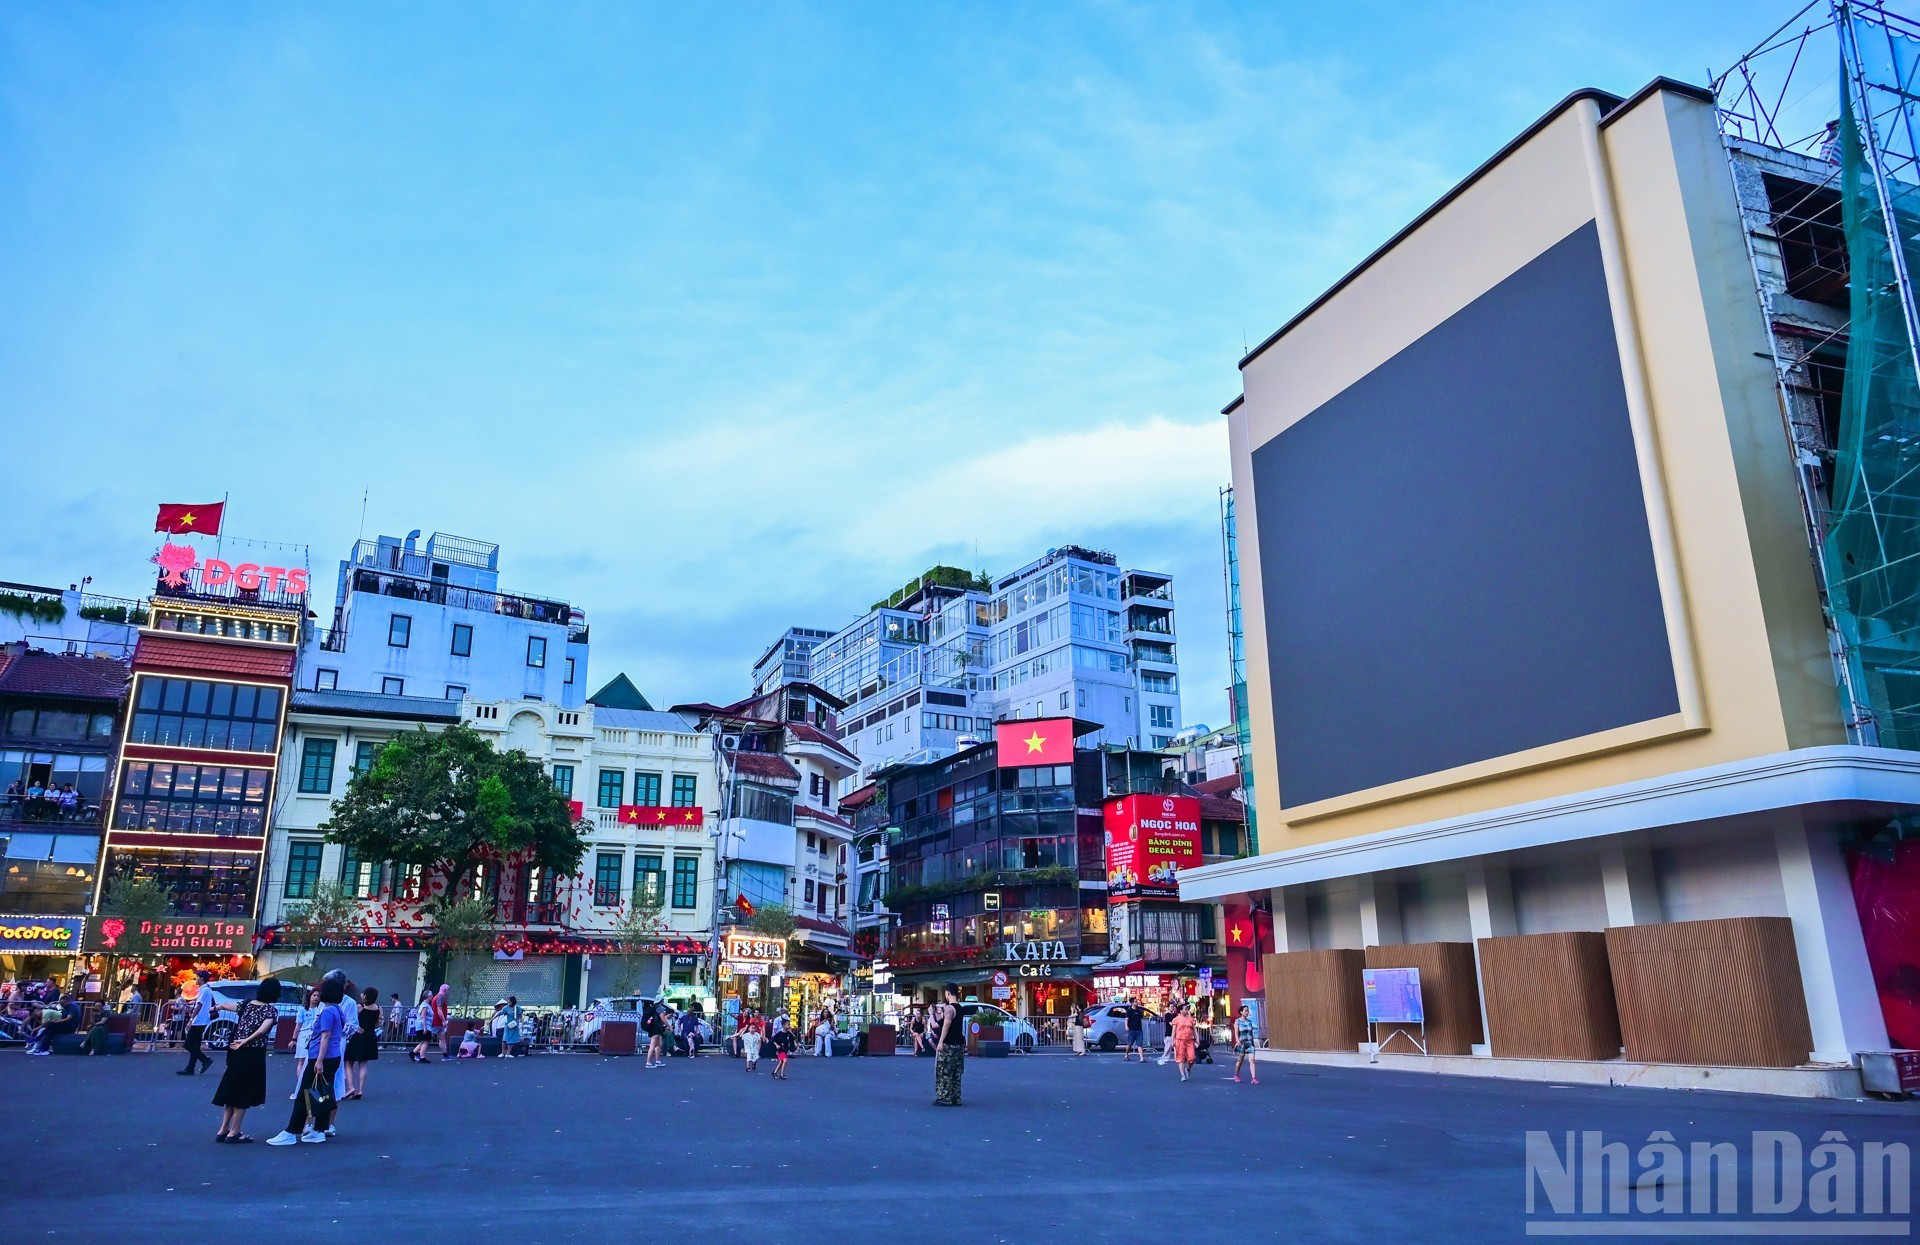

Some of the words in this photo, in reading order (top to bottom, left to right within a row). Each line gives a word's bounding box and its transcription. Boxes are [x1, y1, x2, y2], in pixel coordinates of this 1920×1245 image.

[202, 558, 307, 595] DGTS
[1140, 818, 1172, 831] NGỌC
[1175, 821, 1197, 831] HOA
[139, 919, 210, 937] Dragon
[214, 921, 246, 936] Tea
[190, 936, 234, 949] Giang
[732, 940, 752, 957] FS
[1004, 941, 1068, 961] KAFA
[1019, 963, 1052, 977] Café
